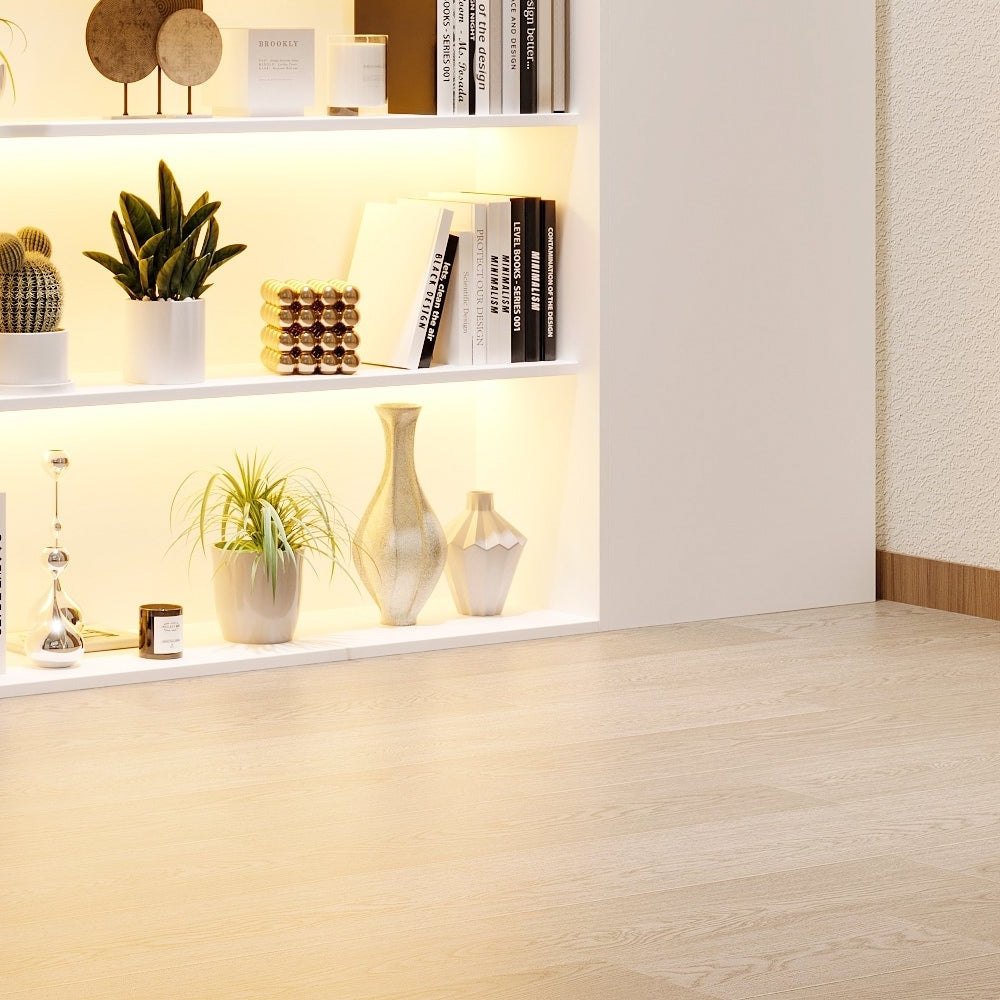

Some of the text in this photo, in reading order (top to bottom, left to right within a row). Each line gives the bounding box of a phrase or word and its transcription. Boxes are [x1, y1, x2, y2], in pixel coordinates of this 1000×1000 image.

[479, 4, 487, 18] of
[479, 21, 487, 42] the
[458, 38, 466, 59] Ms.
[477, 47, 487, 90] design
[526, 28, 535, 70] better...
[458, 62, 466, 103] Posada
[418, 254, 442, 330] BLACK DESIGN
[427, 262, 451, 341] lets, clean the air
[476, 280, 484, 305] OUR
[490, 255, 498, 314] MINIMALISM
[502, 255, 510, 313] MINIMALISM
[531, 251, 540, 311] MINIMALISM
[547, 286, 553, 296] OF
[461, 308, 469, 334] Design
[476, 307, 484, 346] DESIGN
